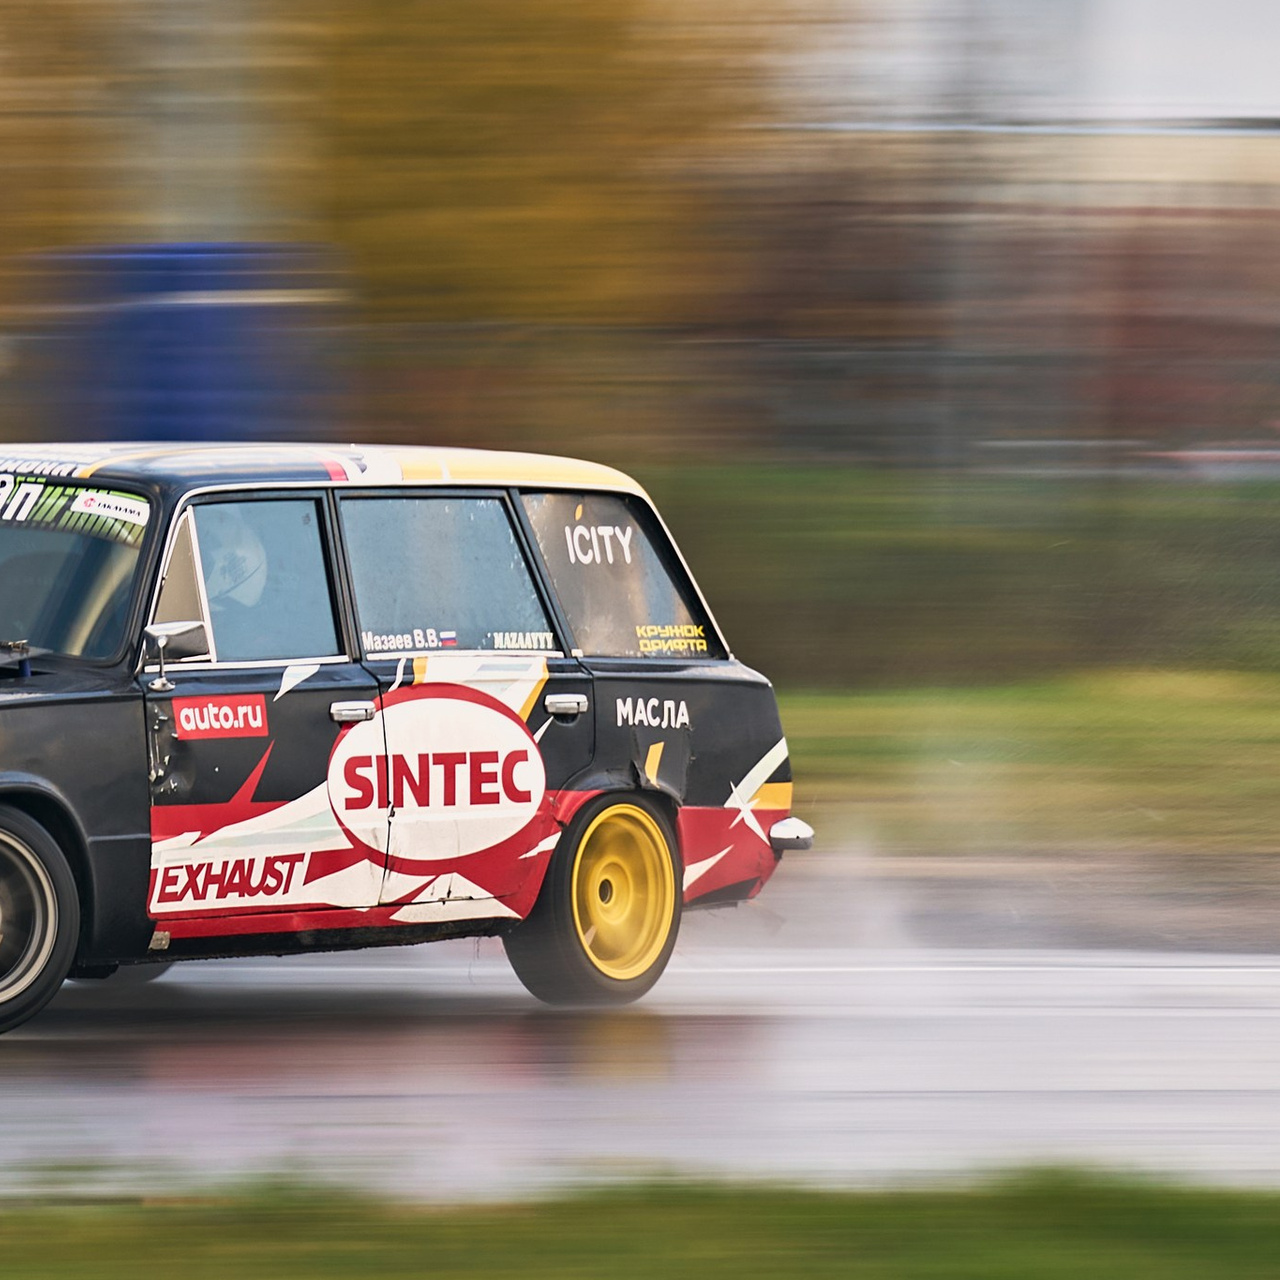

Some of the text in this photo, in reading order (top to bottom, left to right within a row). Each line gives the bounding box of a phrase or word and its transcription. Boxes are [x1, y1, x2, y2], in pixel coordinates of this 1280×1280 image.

[565, 525, 632, 565] ICITY
[361, 631, 412, 651] Мазаев
[635, 625, 705, 638] КРУЖОК
[639, 639, 708, 652] ДРИФТА
[179, 702, 263, 731] auto.ru
[616, 697, 690, 729] МАСЛА
[343, 749, 532, 811] SINTEC
[157, 852, 306, 904] EXHAUST
